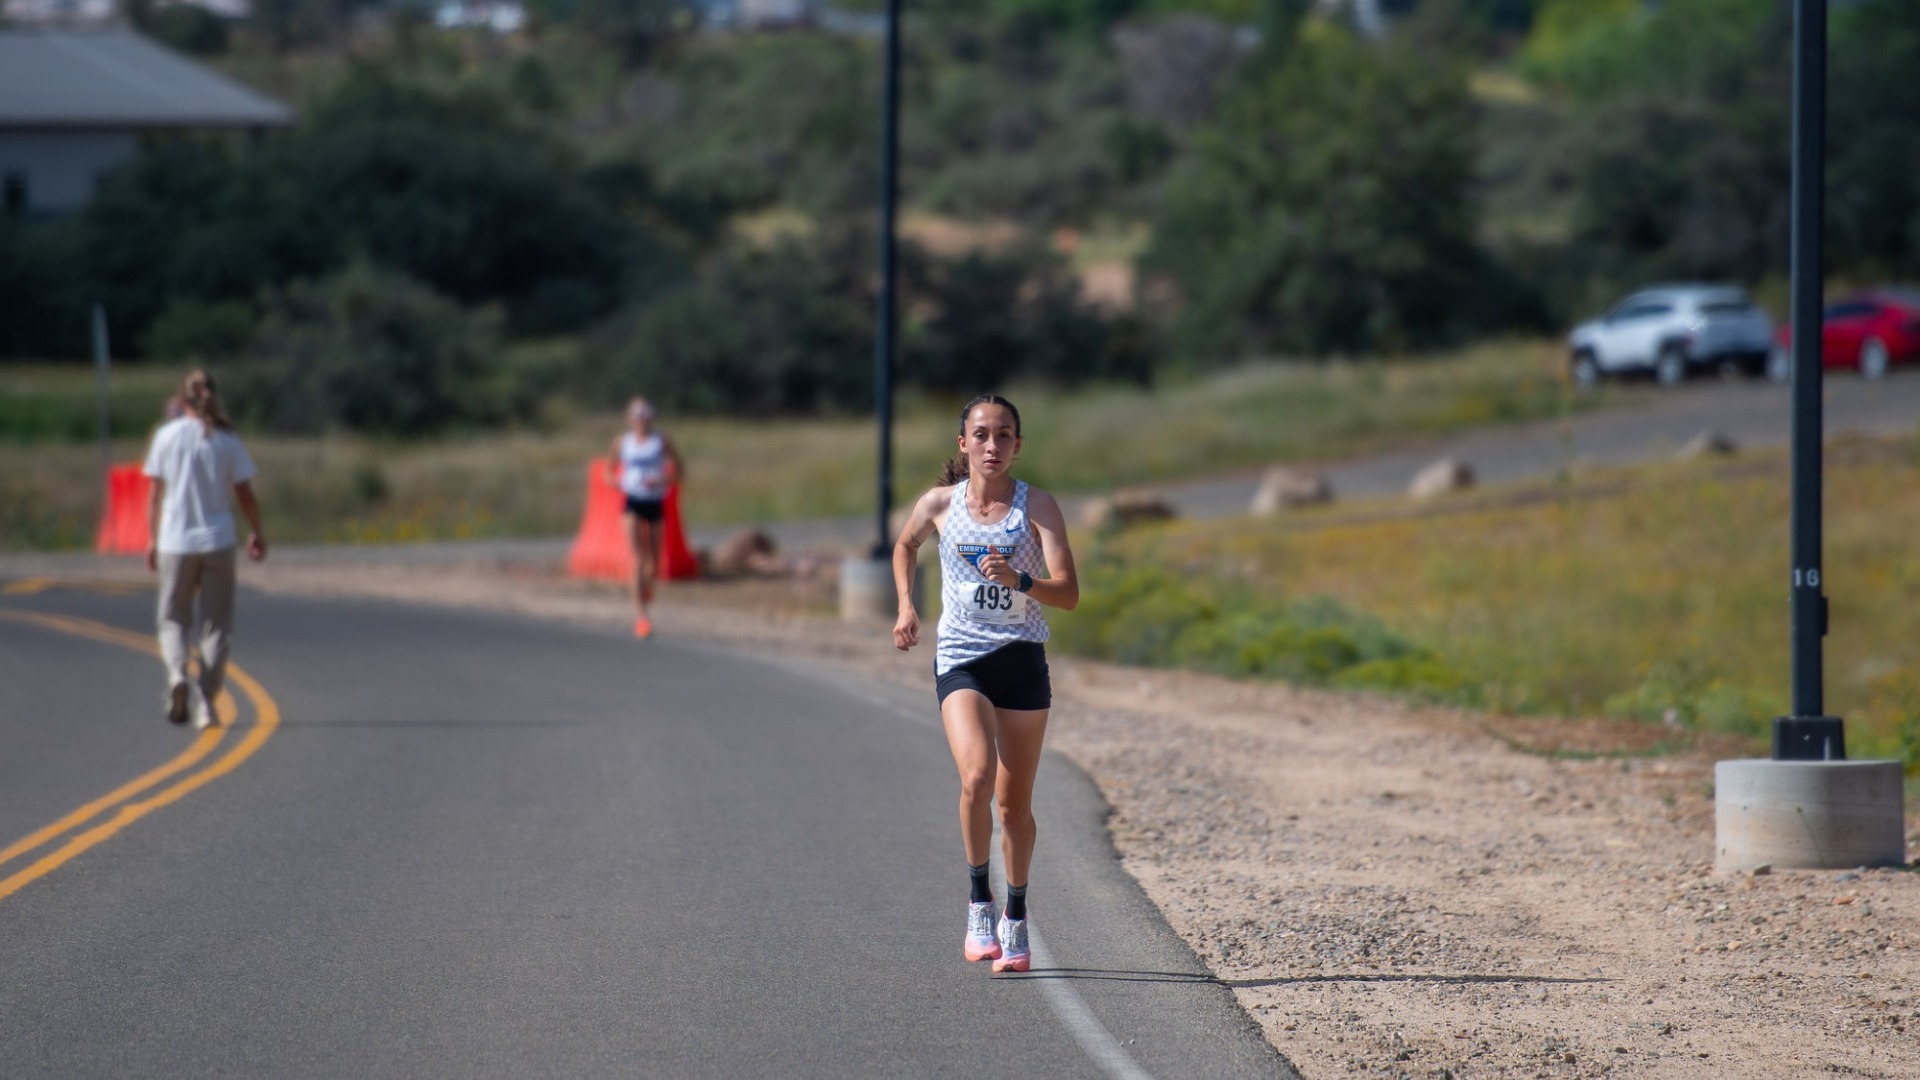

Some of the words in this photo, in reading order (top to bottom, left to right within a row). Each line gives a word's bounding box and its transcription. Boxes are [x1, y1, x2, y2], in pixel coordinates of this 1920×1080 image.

[959, 545, 1014, 554] EMBRY-DLE
[1794, 568, 1819, 587] 16
[973, 584, 1013, 611] 493
